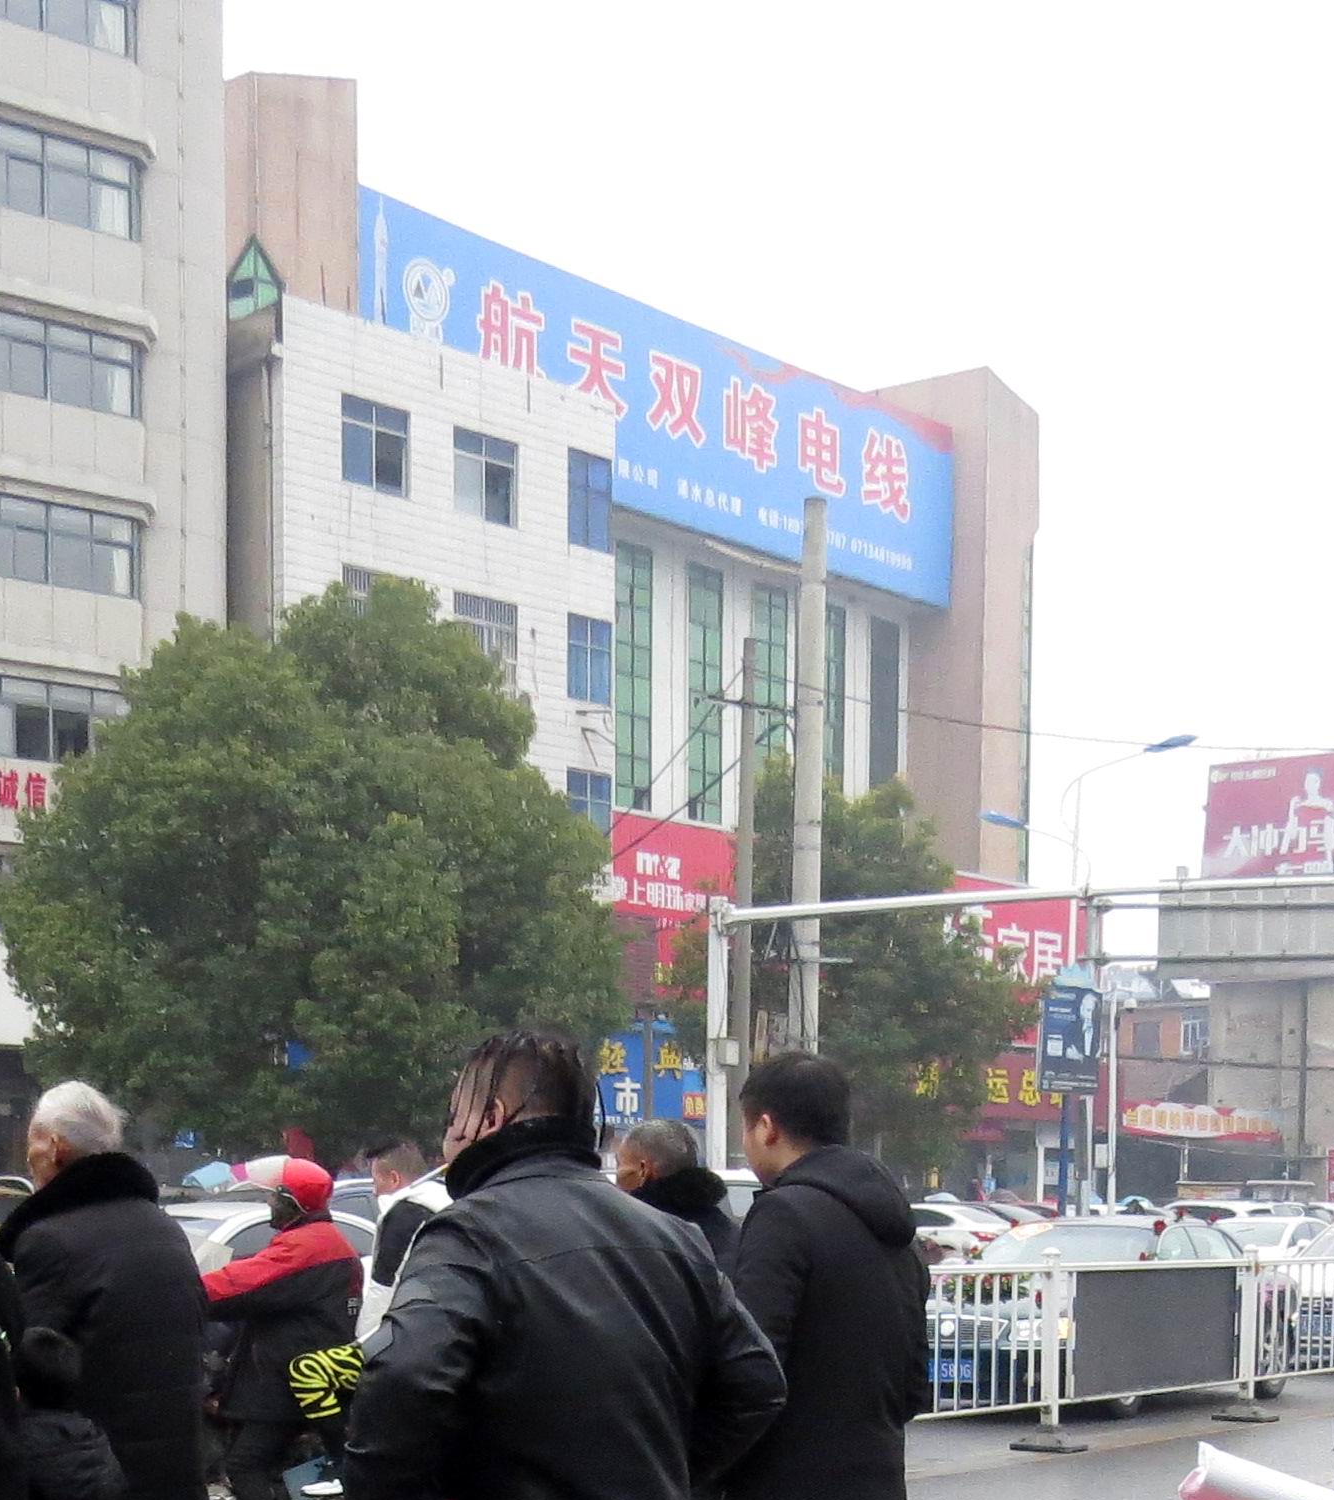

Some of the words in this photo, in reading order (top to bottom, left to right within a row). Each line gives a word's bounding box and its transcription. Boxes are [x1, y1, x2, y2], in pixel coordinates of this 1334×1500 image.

[477, 279, 910, 523] 航天双峰电线
